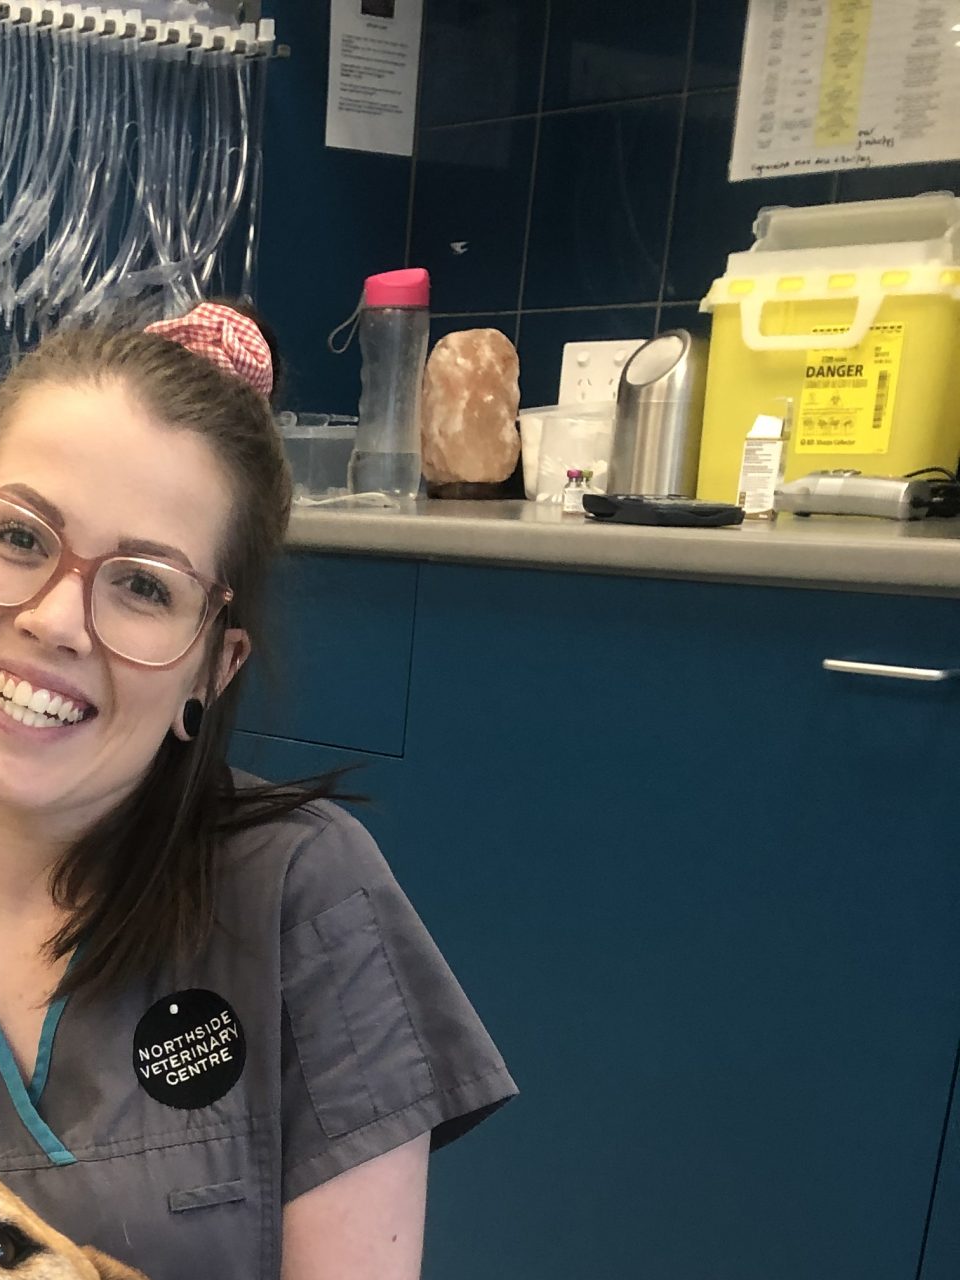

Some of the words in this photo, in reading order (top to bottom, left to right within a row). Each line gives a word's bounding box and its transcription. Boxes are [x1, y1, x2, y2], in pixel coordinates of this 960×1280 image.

[806, 364, 864, 378] DANGER
[138, 1010, 232, 1062] NORTHSIDE
[139, 1022, 239, 1079] VETERINARY
[165, 1047, 233, 1086] CENTRE
